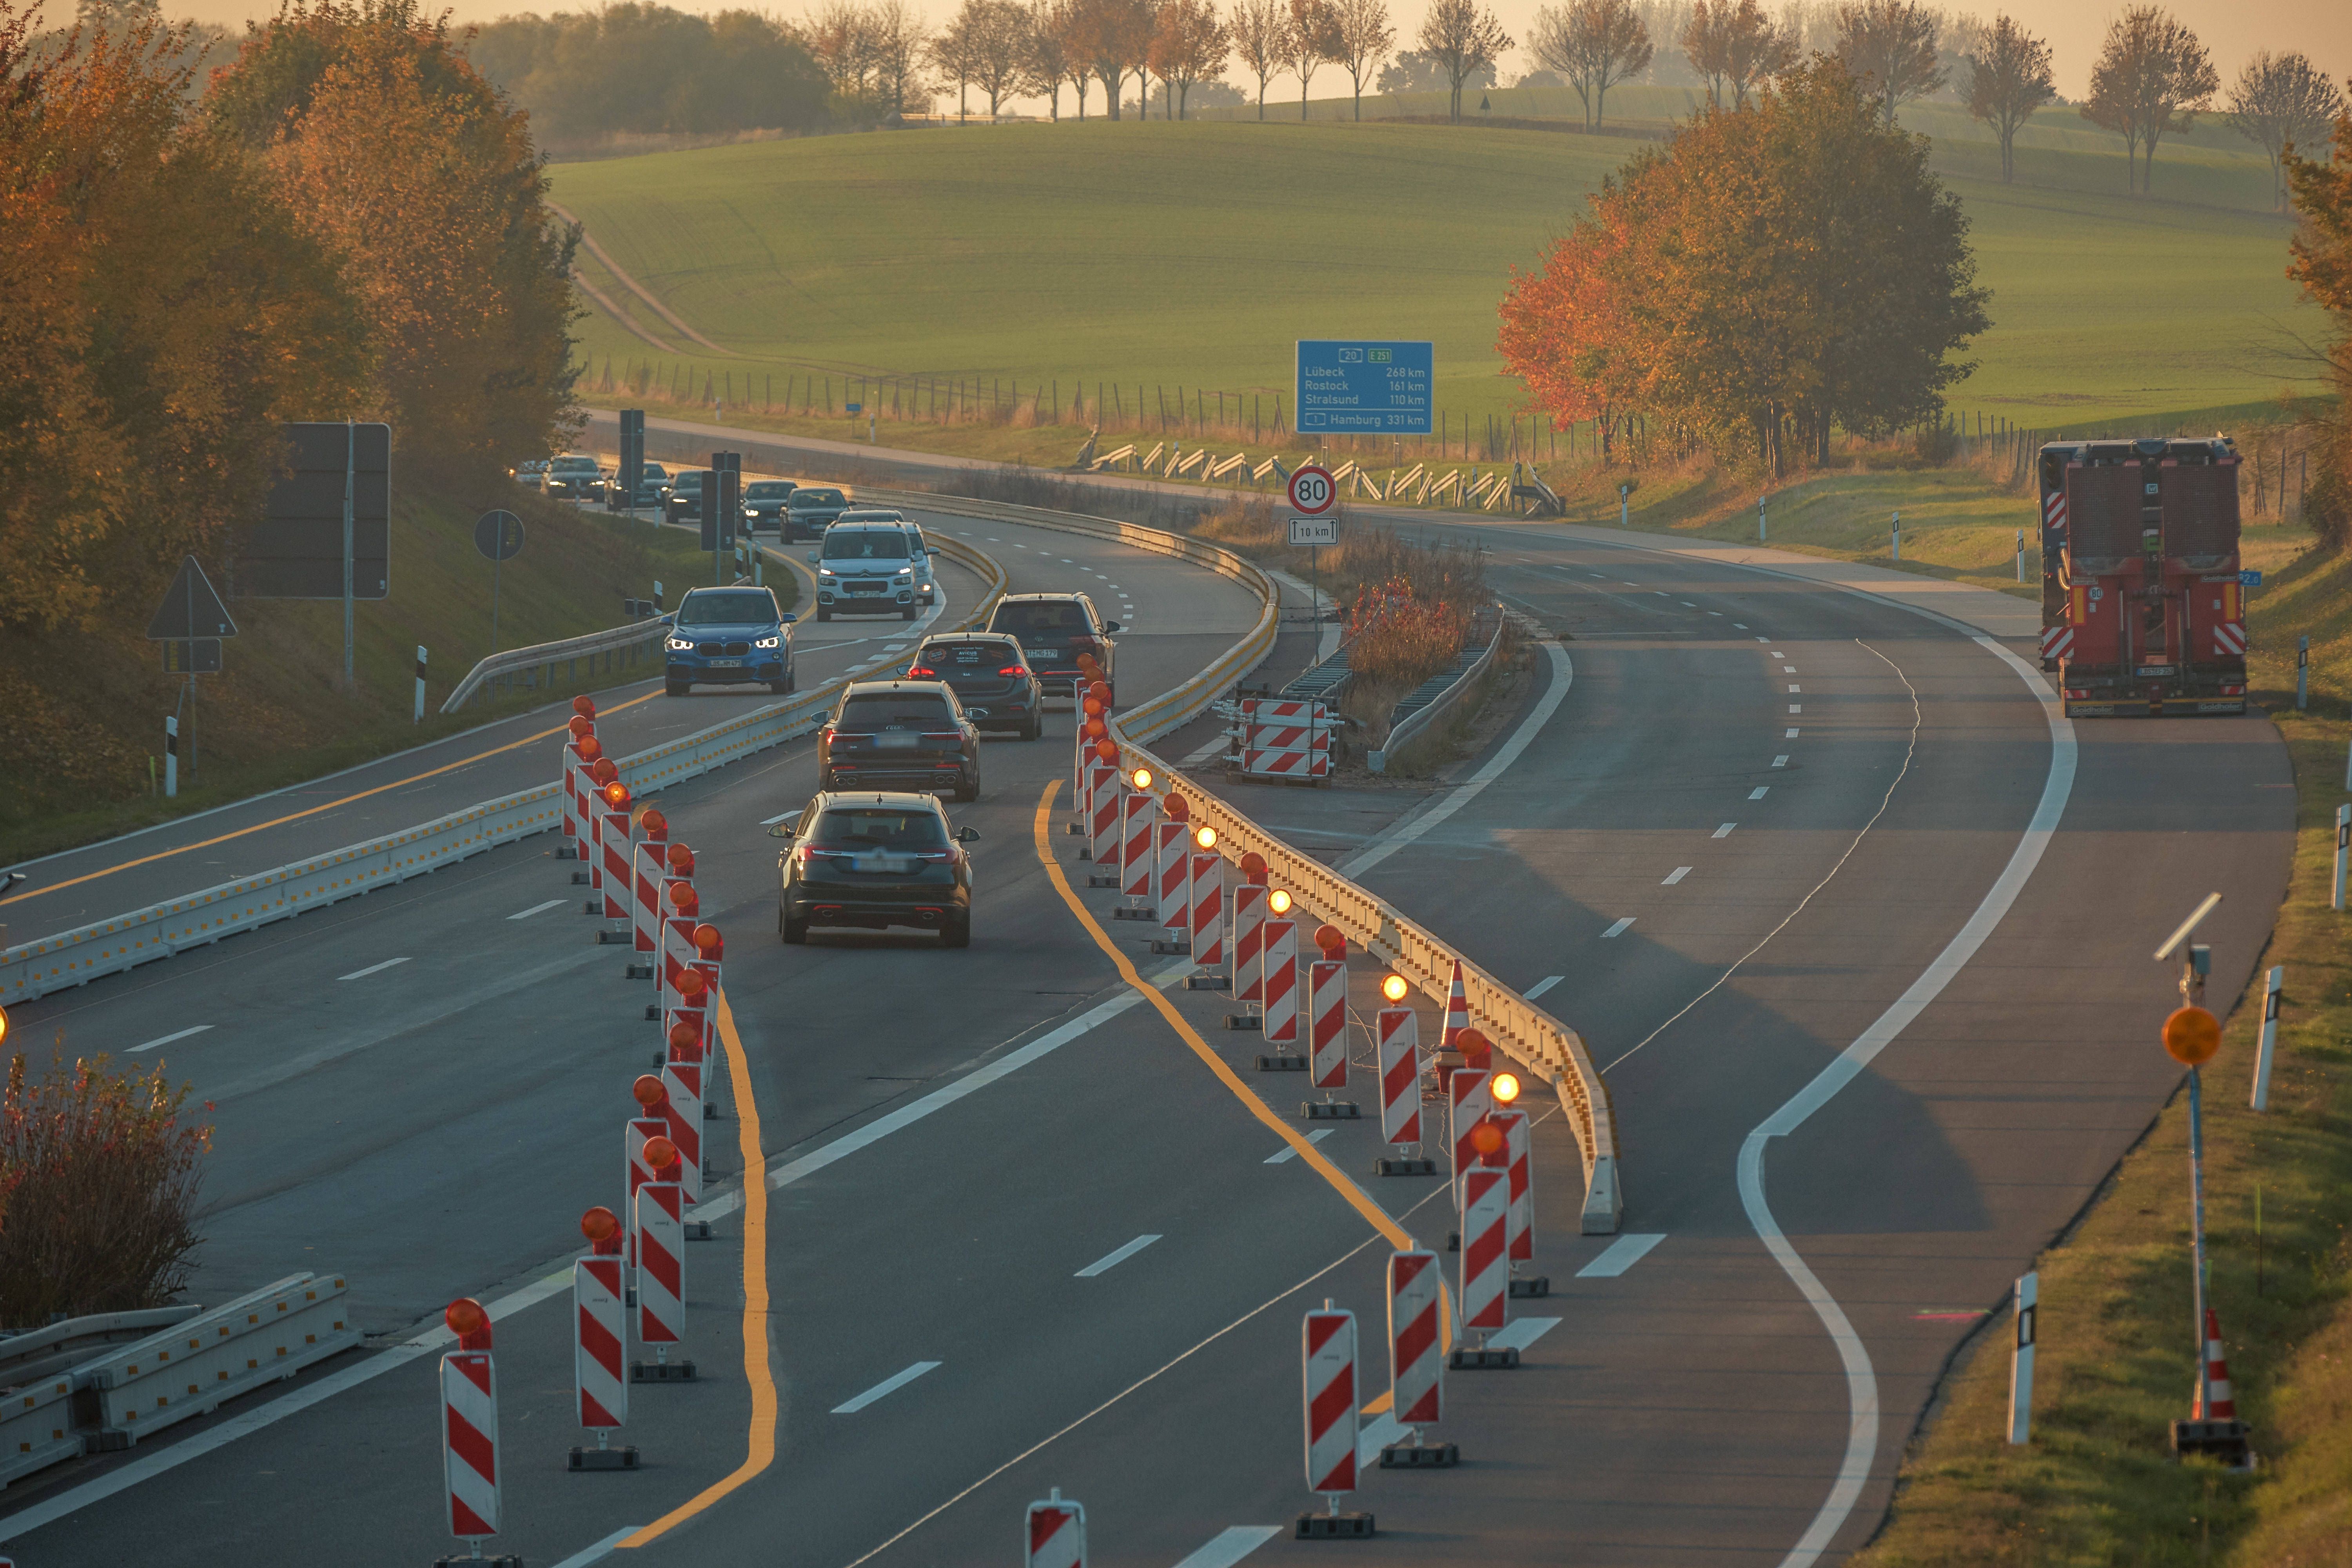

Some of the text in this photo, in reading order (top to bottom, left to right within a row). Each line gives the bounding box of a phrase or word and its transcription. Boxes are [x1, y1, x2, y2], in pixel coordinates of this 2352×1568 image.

[1345, 351, 1357, 360] 20
[1370, 351, 1390, 360] E 251
[1305, 367, 1425, 377] Lübeck 268 km
[1305, 380, 1425, 391] Rostock 161 km
[1305, 394, 1425, 405] Stralsund 110 km
[1331, 415, 1381, 426] Hamburg
[1387, 415, 1404, 425] 331
[1408, 415, 1425, 425] km
[1298, 479, 1325, 501] 80
[1300, 527, 1328, 537] 10 km
[2092, 588, 2102, 598] 80
